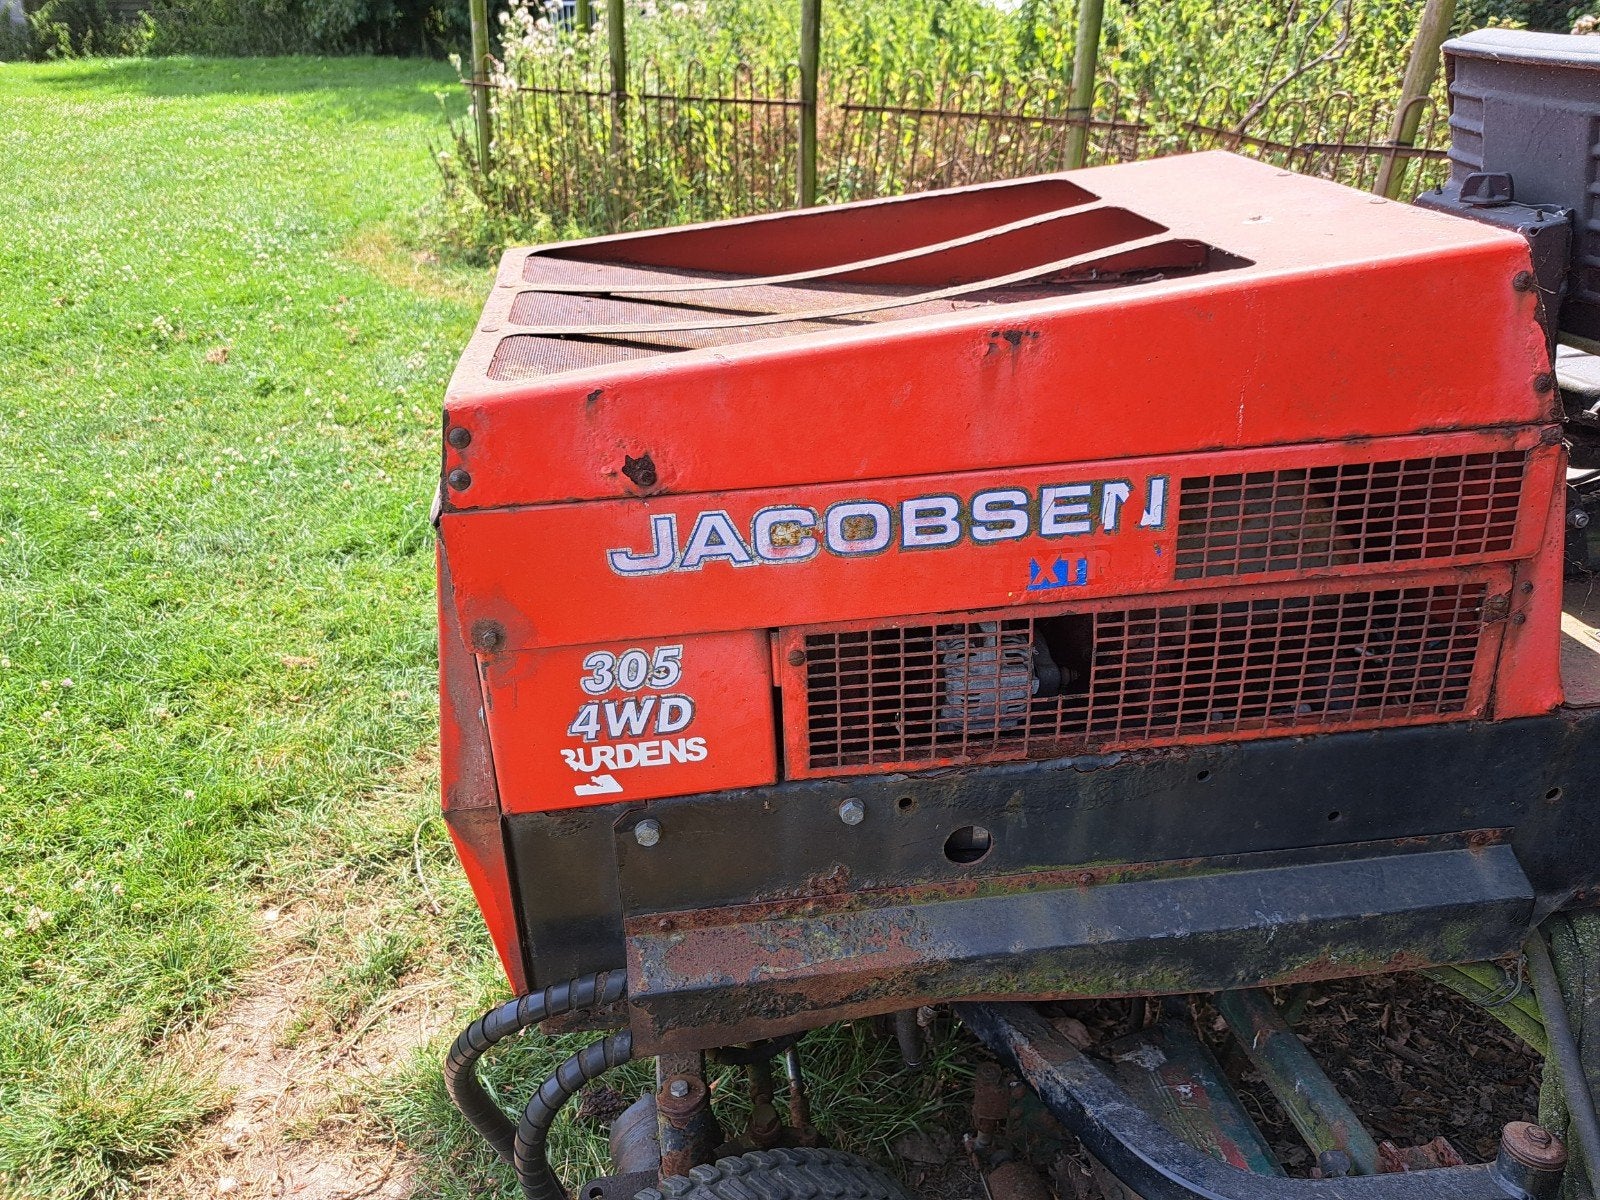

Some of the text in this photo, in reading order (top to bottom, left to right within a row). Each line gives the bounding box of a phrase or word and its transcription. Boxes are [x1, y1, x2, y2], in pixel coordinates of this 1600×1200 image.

[607, 476, 1168, 575] JACOBSEN
[580, 645, 683, 695] 305
[567, 695, 696, 742] 4WD
